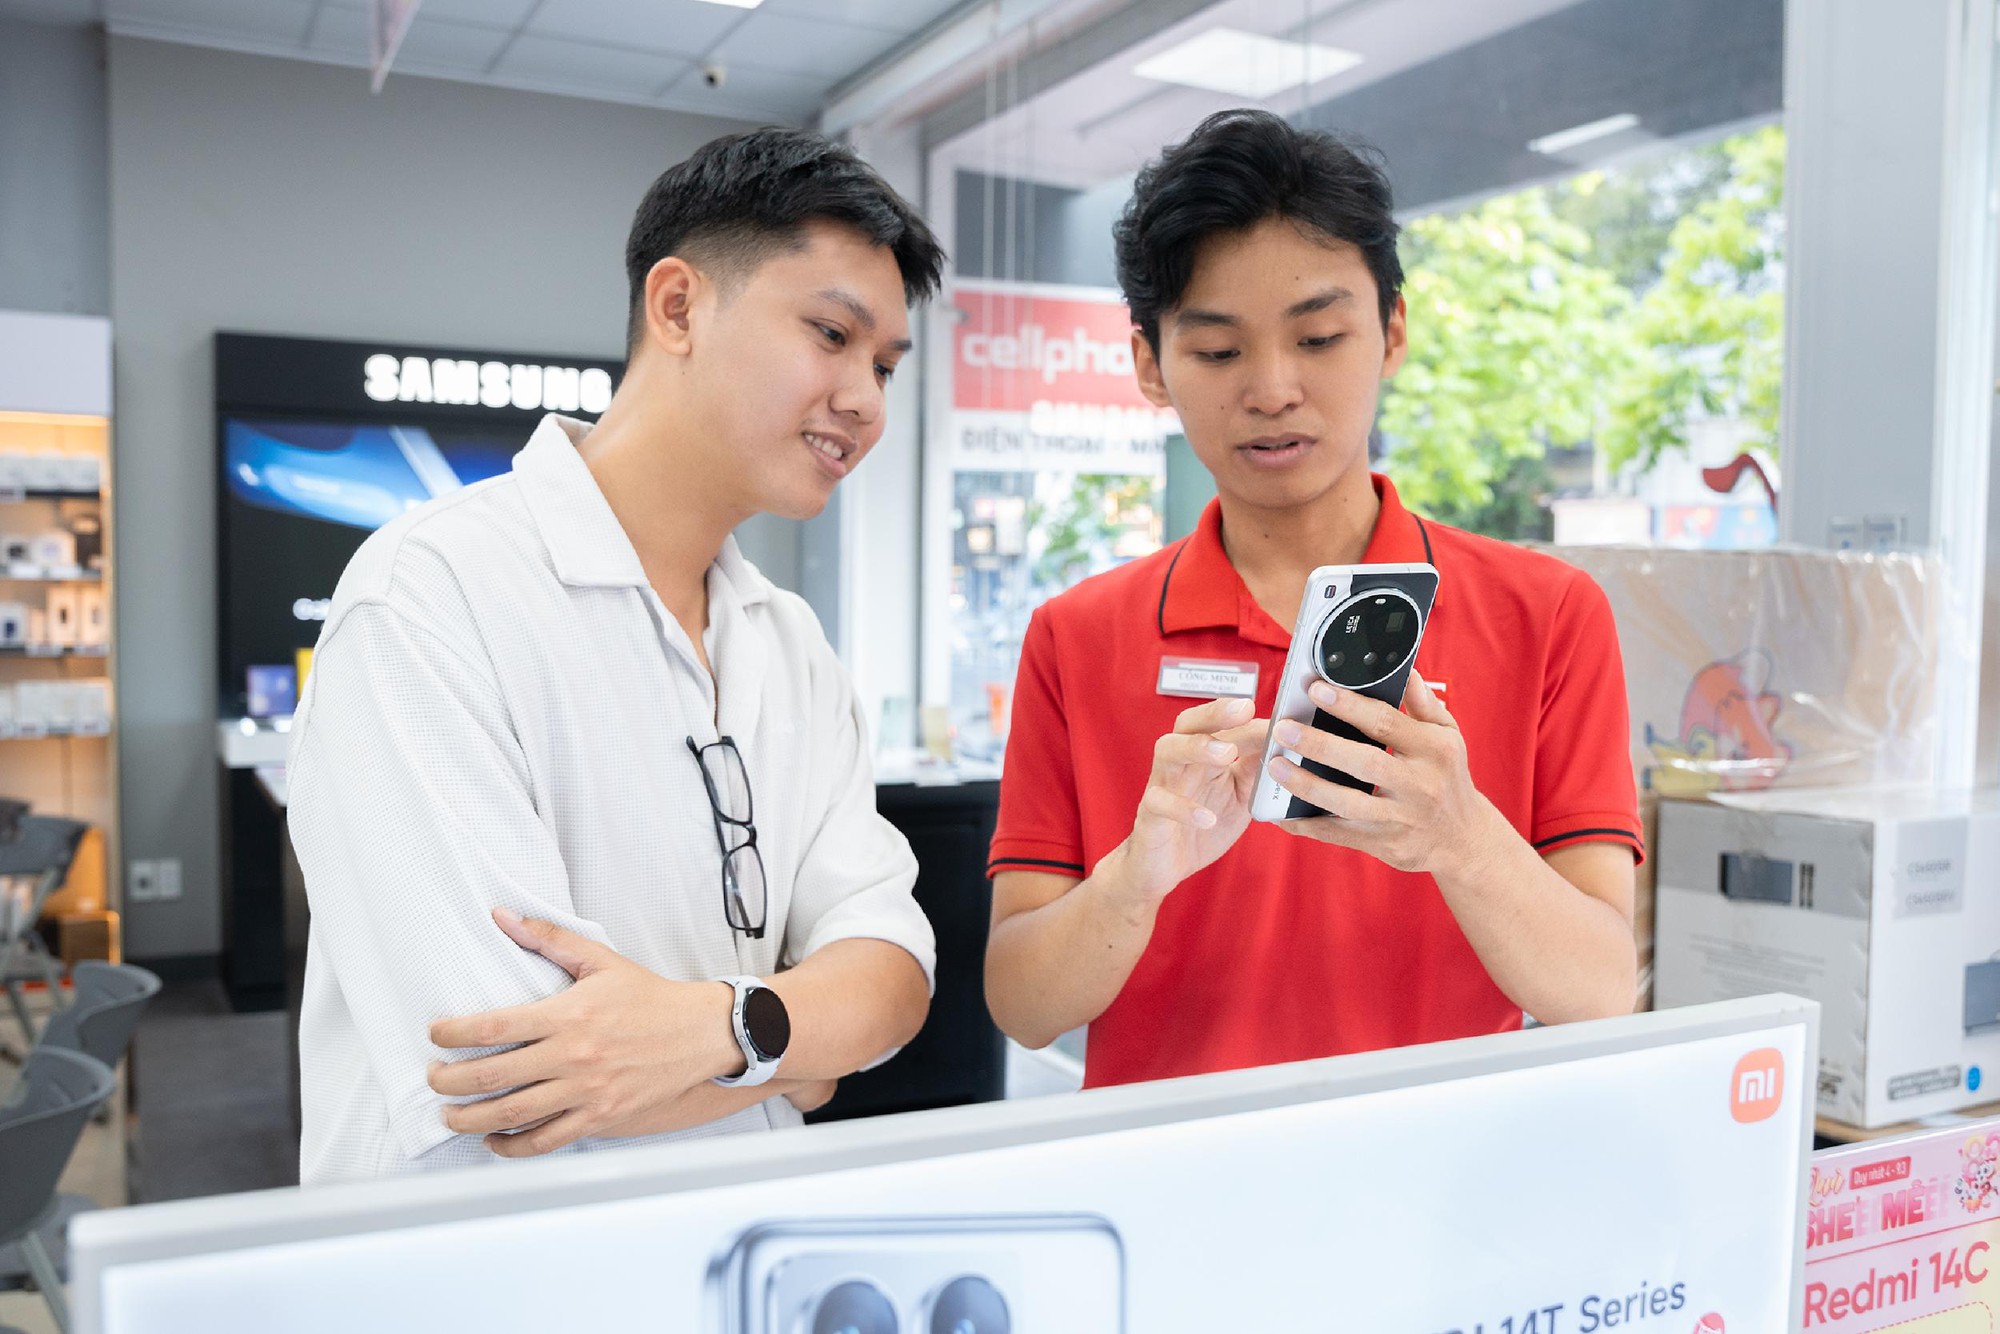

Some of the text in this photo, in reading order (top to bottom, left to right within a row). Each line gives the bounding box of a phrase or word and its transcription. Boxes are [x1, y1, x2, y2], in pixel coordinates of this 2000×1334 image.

[364, 354, 613, 413] SAMSUNG
[1579, 1281, 1685, 1334] Series
[1803, 1241, 1990, 1328] Redmi 14C
